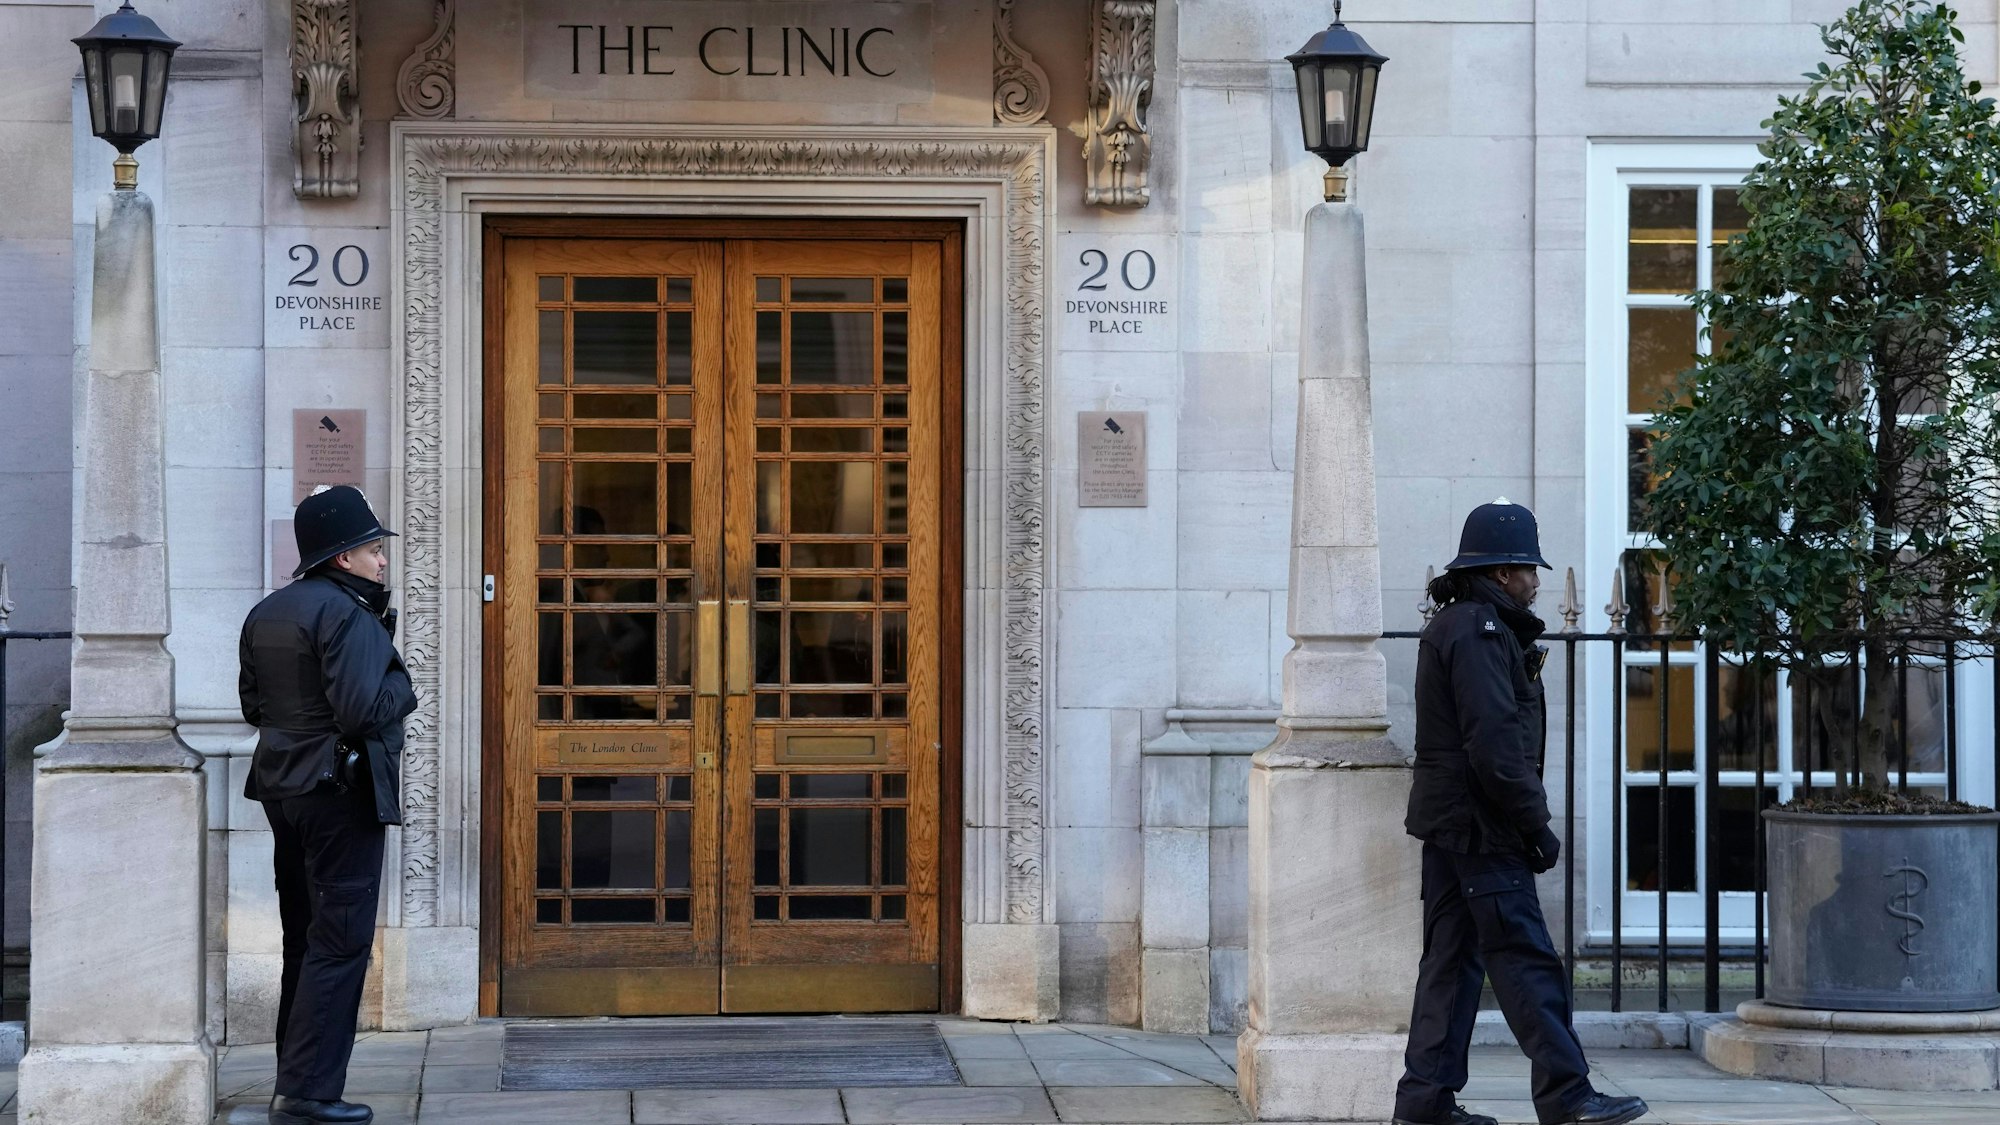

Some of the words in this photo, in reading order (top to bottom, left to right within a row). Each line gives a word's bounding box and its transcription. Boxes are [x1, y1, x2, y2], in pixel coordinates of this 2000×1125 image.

[558, 25, 676, 75] THE
[699, 27, 897, 77] CLINIC
[275, 296, 382, 310] DEVONSHIRE
[1066, 300, 1168, 314] DEVONSHIRE
[299, 316, 355, 330] PLACE
[1089, 320, 1143, 334] PLACE
[570, 742, 588, 752] The
[592, 742, 626, 753] London
[631, 742, 658, 752] Clinic
